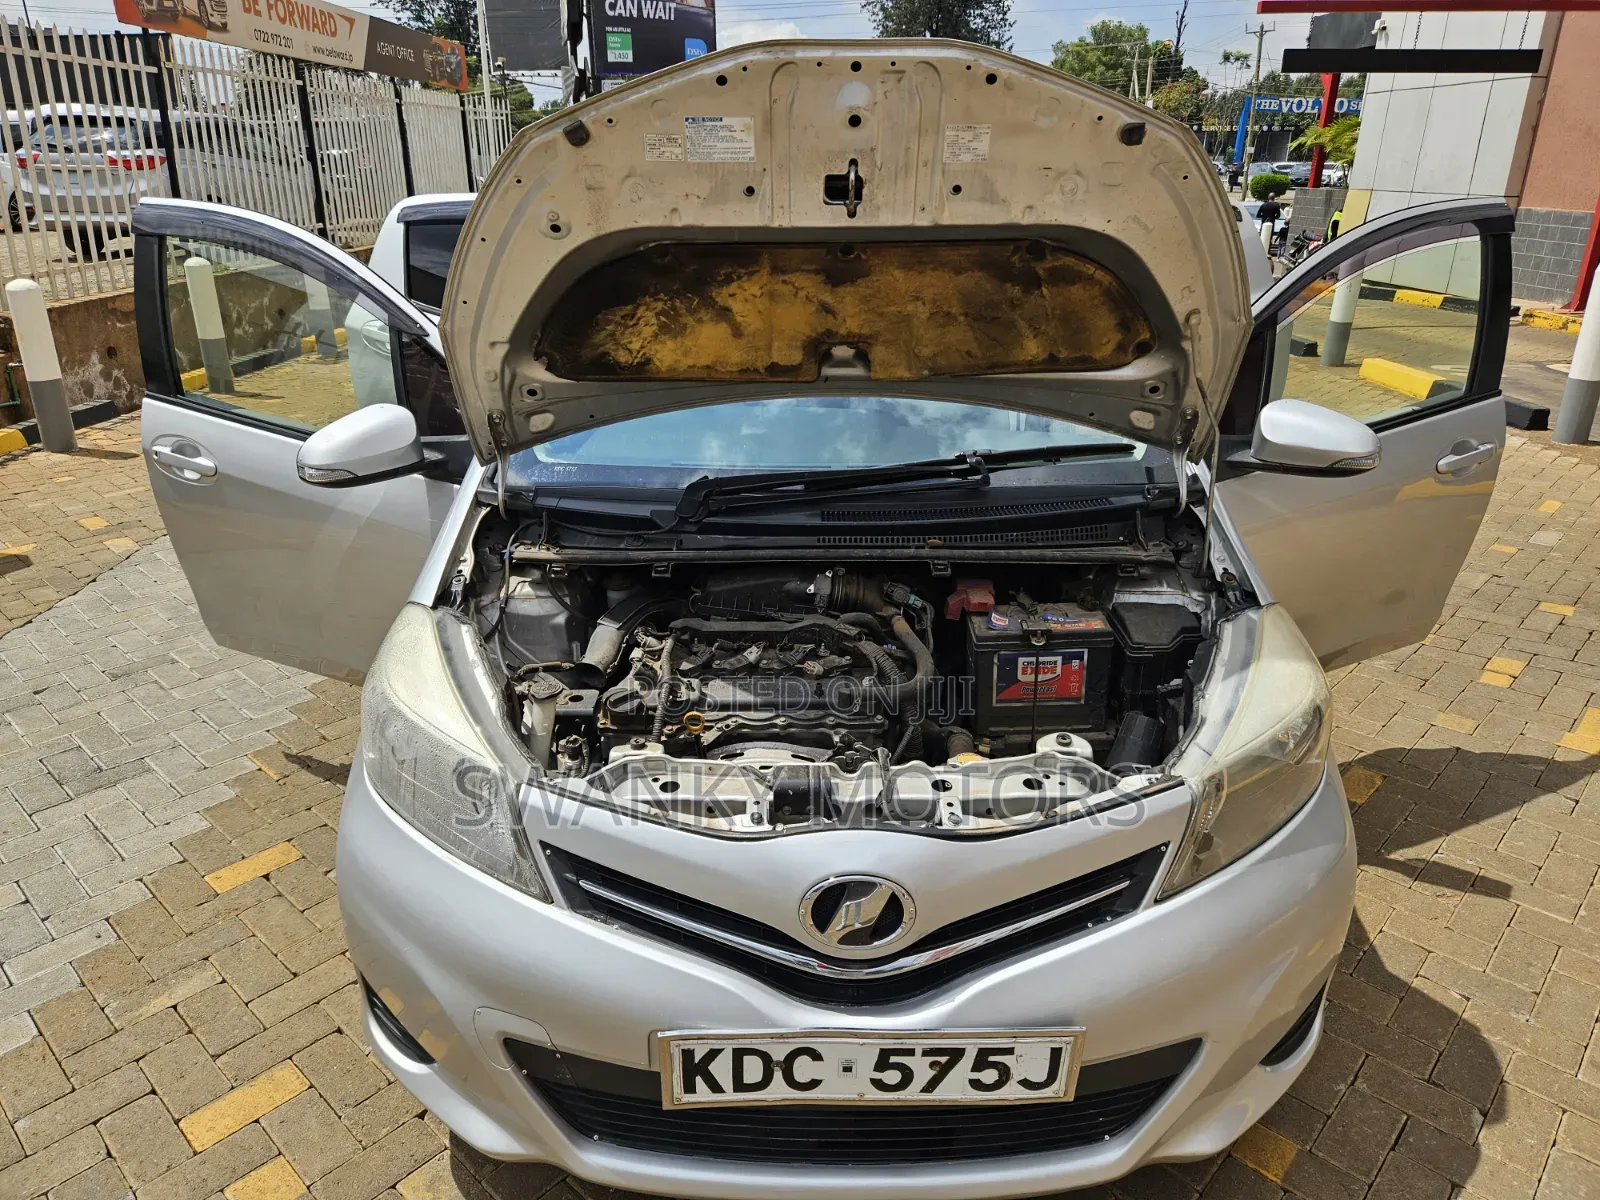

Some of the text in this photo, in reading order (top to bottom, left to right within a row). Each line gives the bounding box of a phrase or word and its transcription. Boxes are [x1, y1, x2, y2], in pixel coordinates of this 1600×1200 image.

[242, 0, 338, 38] BE FORWARD
[604, 0, 677, 20] CAN WAIT
[253, 28, 294, 49] 0722 972 201
[376, 41, 415, 62] AGENT OFFICE
[1255, 98, 1279, 110] THE
[1279, 97, 1349, 114] VOLO
[682, 1045, 1064, 1095] KDC 575J
